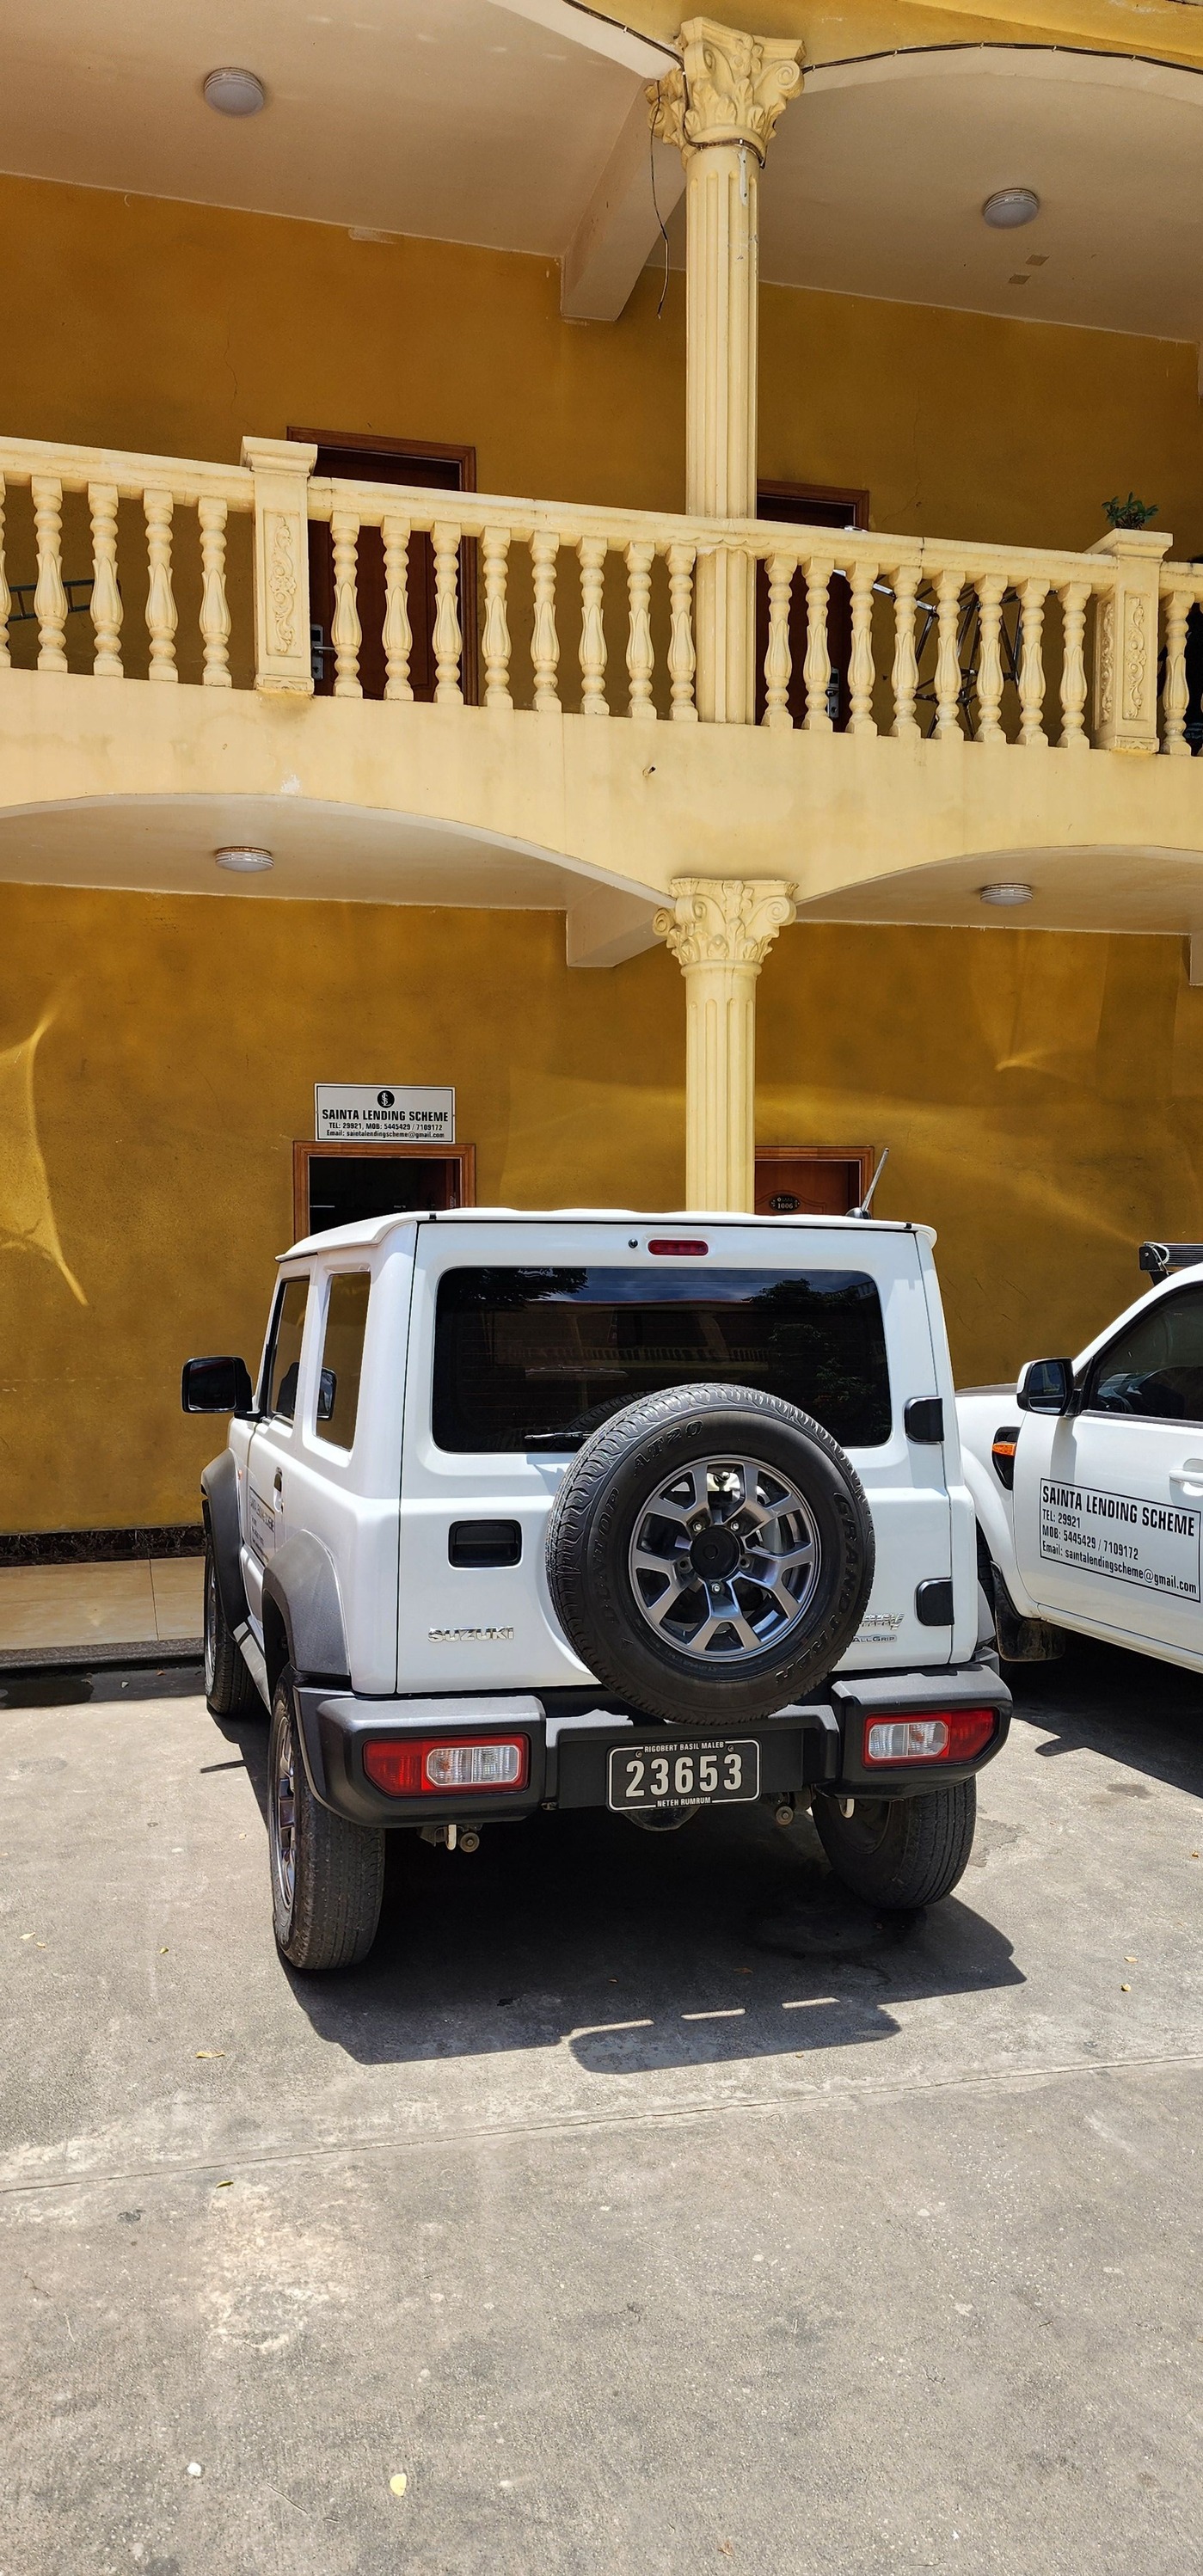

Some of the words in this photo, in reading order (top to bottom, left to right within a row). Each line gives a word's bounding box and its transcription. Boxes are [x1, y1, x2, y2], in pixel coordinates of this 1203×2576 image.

[322, 1109, 359, 1120] SAINTA
[362, 1110, 406, 1121] LENDING
[408, 1111, 449, 1122] SCHEME
[342, 1122, 365, 1131] 29921,
[1042, 1485, 1083, 1511] SAINTA
[1086, 1494, 1138, 1524] LENDING
[1142, 1506, 1194, 1536] SCHEME
[1042, 1508, 1056, 1523] TEL:
[1058, 1512, 1081, 1529] 29921
[1042, 1524, 1061, 1540] MOB:
[1063, 1530, 1096, 1549] 5445429
[1103, 1540, 1139, 1561] 7109172
[1042, 1540, 1063, 1556] Email:
[1065, 1549, 1197, 1594] saintalendingscheme@gmail.com
[428, 1625, 515, 1643] SUZUKI
[644, 1744, 678, 1753] RIGOBERT
[701, 1741, 725, 1750] MALEB
[625, 1753, 742, 1798] 23653
[657, 1798, 679, 1807] NETEH
[680, 1796, 711, 1806] RUMRUM
